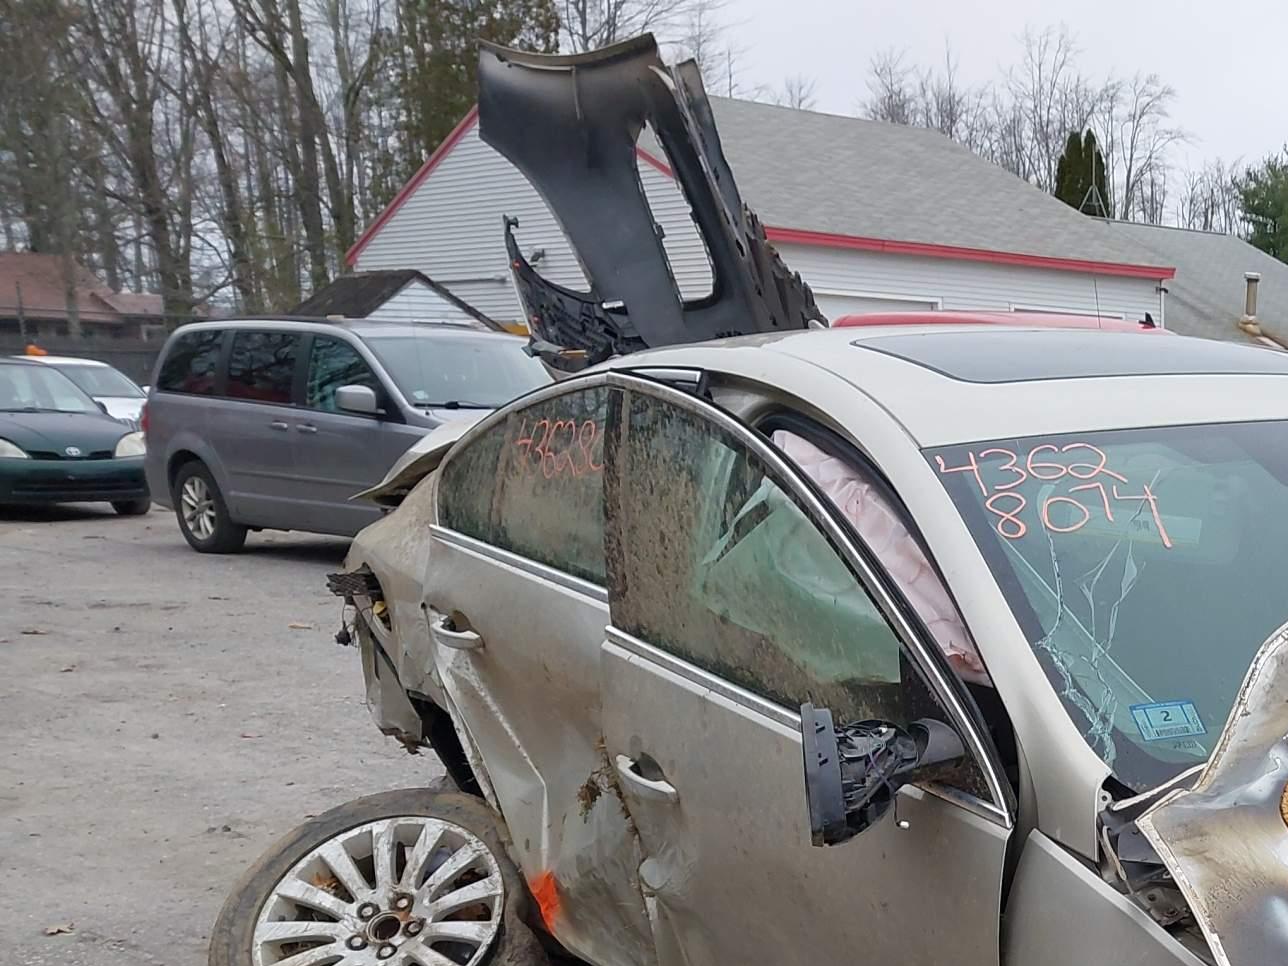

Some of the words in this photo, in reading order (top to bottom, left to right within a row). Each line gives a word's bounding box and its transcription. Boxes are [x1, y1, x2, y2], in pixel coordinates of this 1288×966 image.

[935, 442, 1128, 497] 4362
[985, 481, 1173, 550] 8074
[1160, 710, 1173, 722] 2
